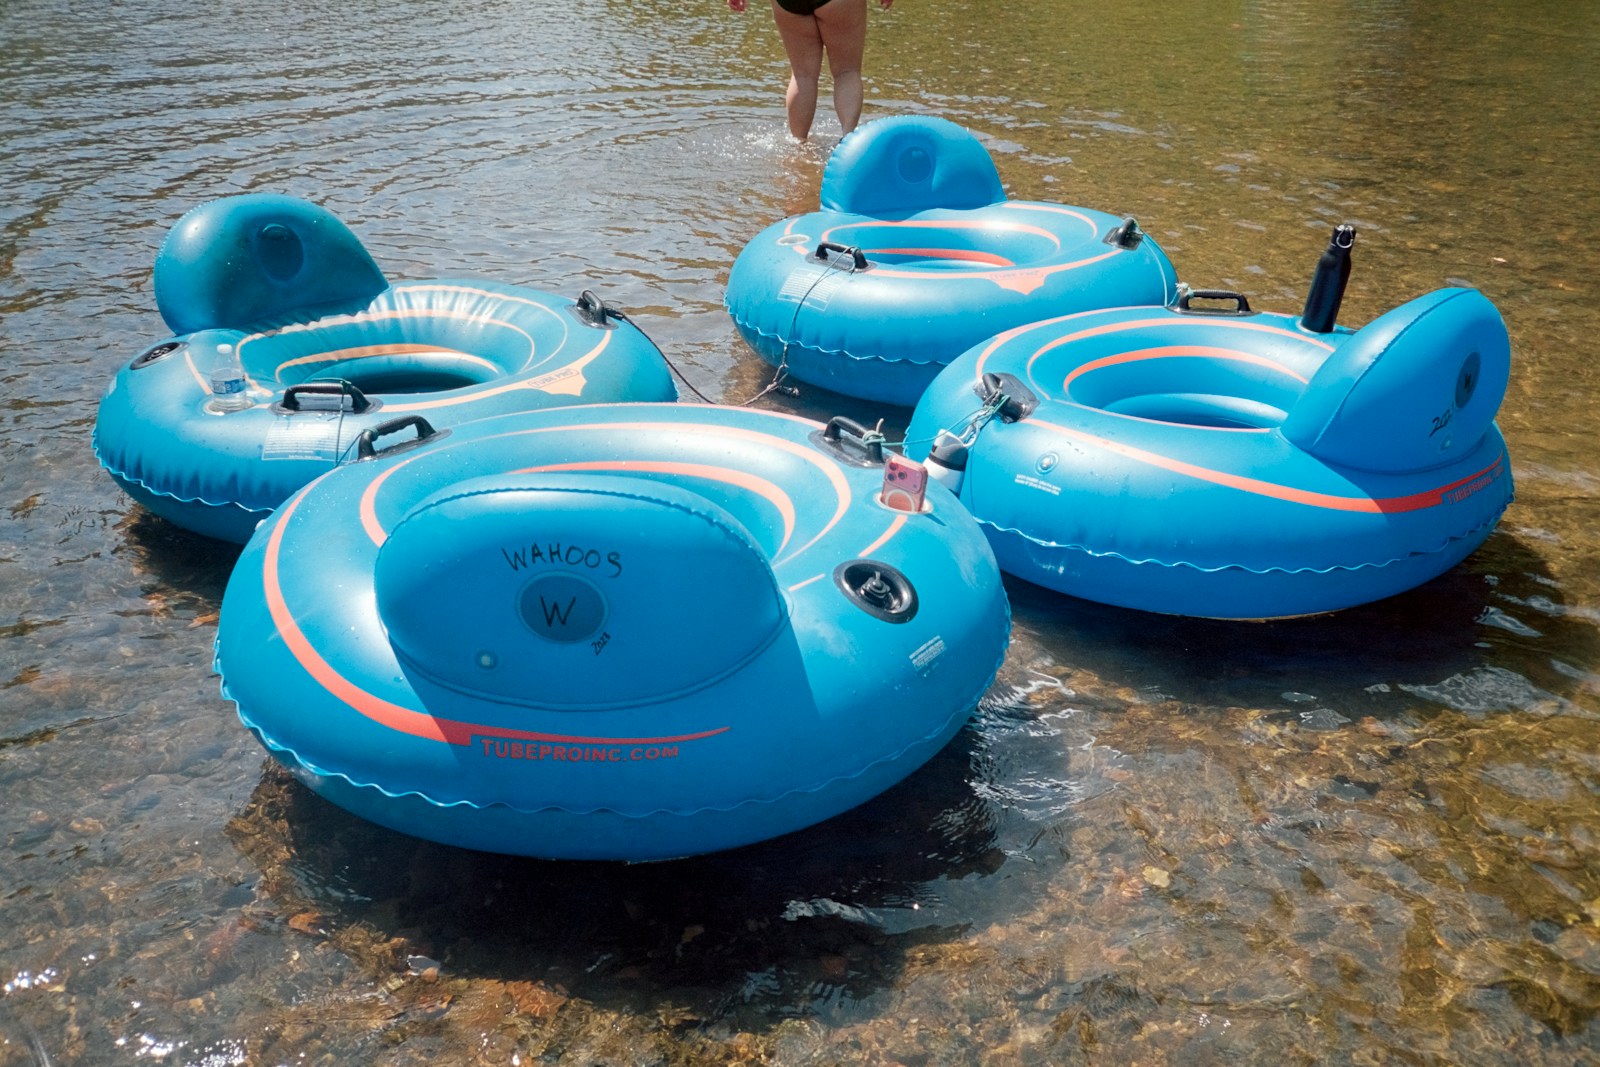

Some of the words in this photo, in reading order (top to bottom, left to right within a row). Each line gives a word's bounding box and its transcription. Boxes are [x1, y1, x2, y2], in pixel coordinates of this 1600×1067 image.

[501, 542, 622, 578] WAHOOS
[540, 595, 576, 627] W
[481, 739, 679, 762] TUBEPROINC.COM
